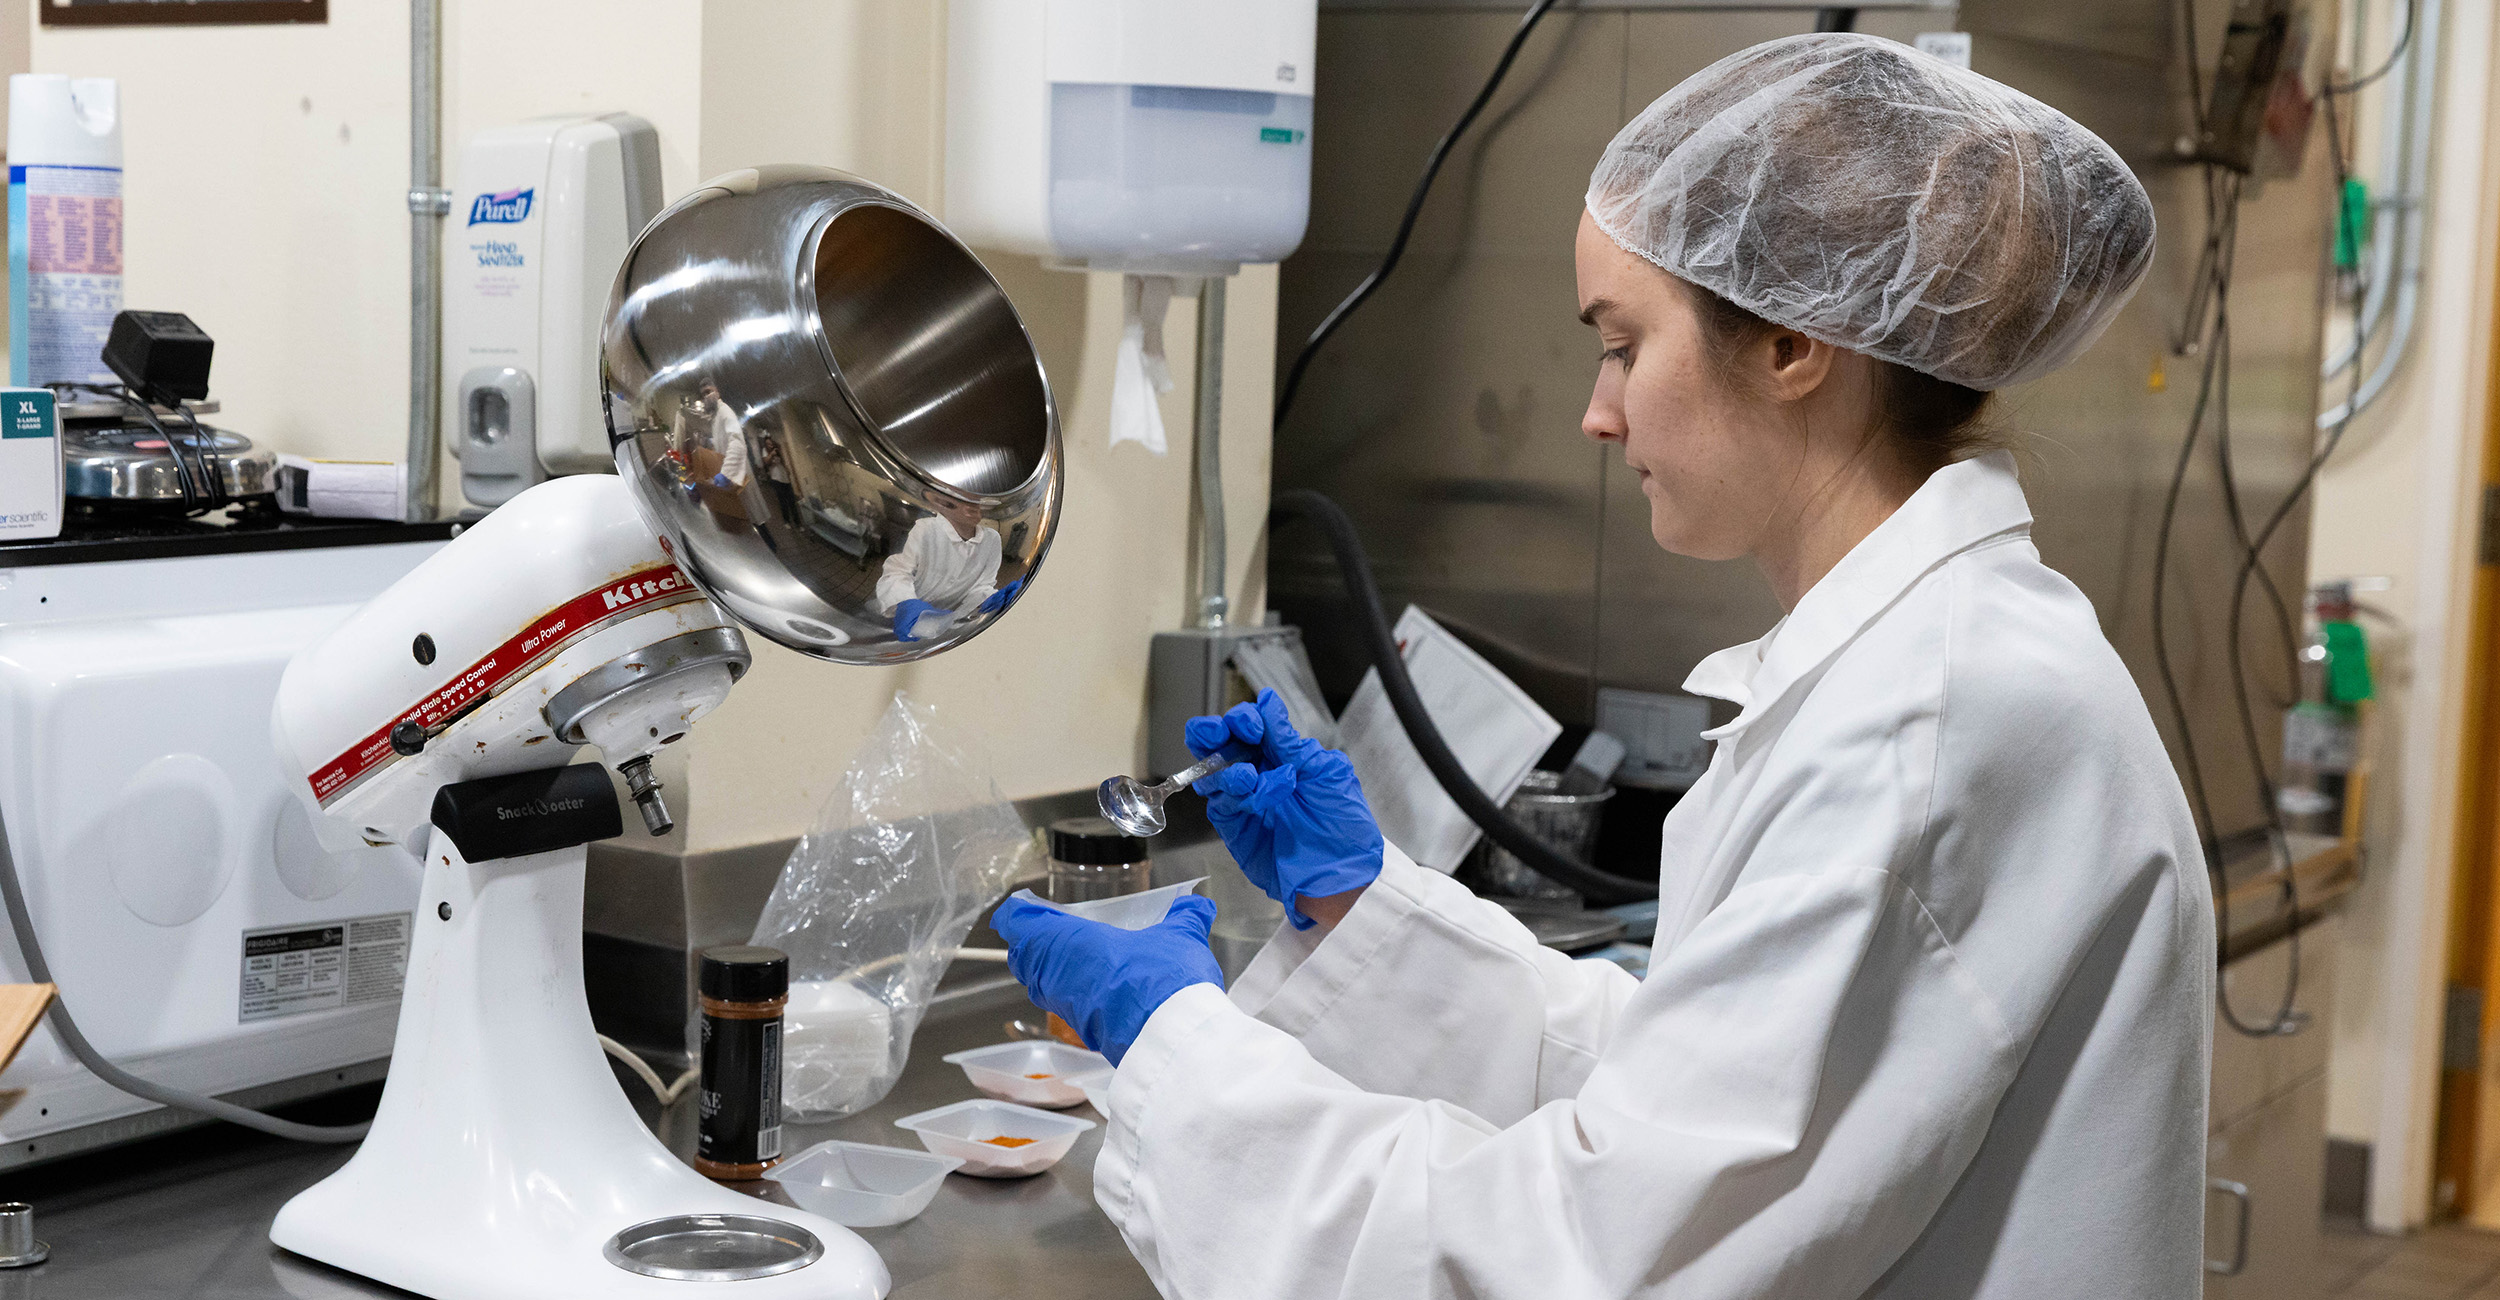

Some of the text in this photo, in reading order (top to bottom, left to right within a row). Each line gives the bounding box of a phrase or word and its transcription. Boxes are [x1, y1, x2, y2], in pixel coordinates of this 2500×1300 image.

[475, 196, 528, 221] Purell
[19, 401, 37, 414] XL
[9, 511, 48, 524] scientific
[521, 636, 540, 653] Ultra
[540, 619, 566, 641] Power
[420, 697, 441, 713] State
[440, 678, 466, 700] Speed
[466, 658, 497, 682] Control
[426, 711, 437, 722] Stir
[442, 704, 448, 712] 2
[468, 686, 474, 694] 8
[476, 679, 486, 689] 10
[497, 803, 535, 820] Snack
